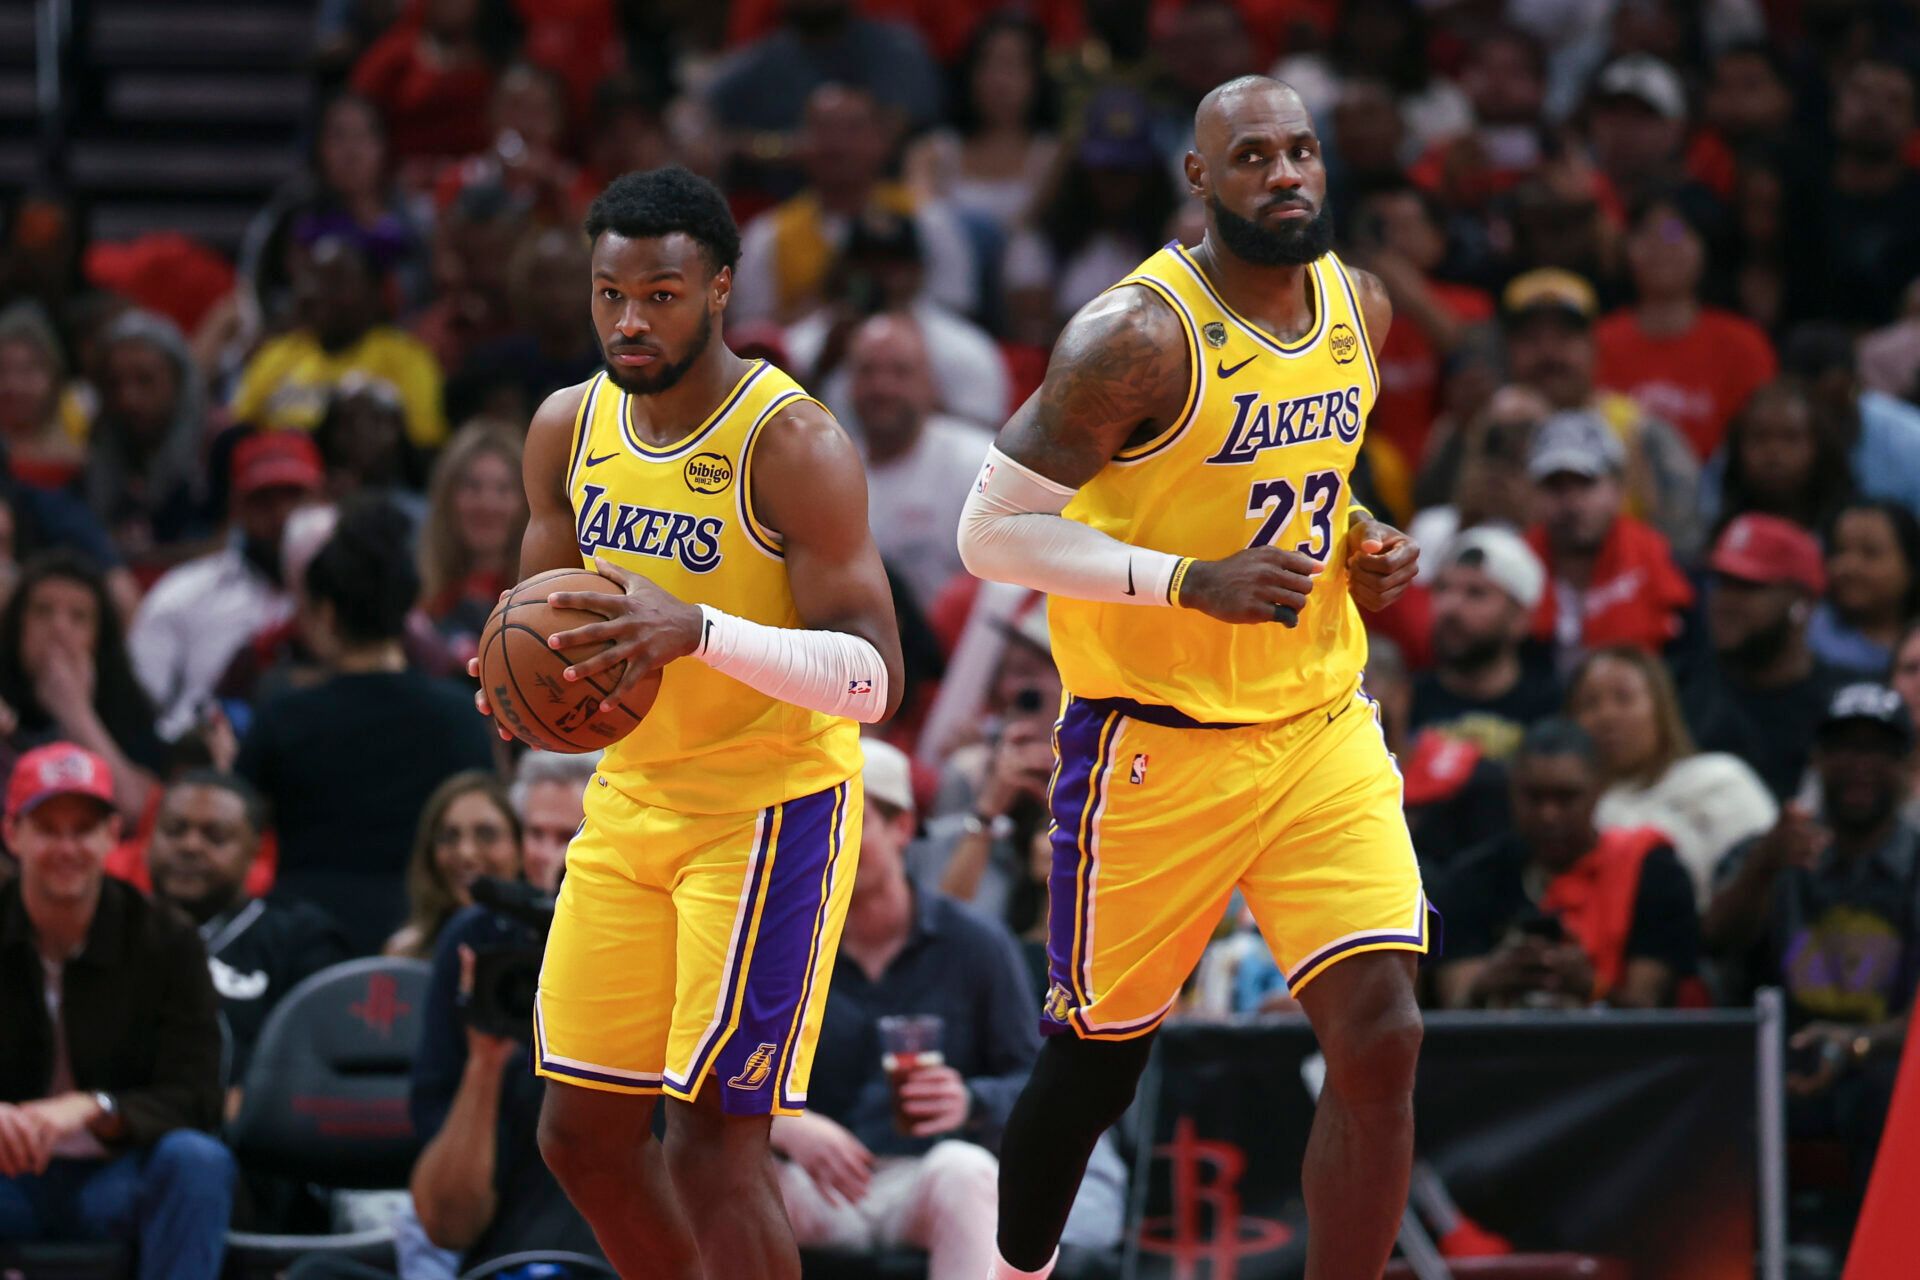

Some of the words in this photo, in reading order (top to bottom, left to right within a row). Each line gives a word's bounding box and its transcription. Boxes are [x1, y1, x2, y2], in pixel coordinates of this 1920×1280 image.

[1331, 335, 1355, 351] bibigo
[1203, 385, 1361, 466] LAKERS
[689, 462, 730, 484] bibigo
[576, 484, 725, 574] LAKERS
[1245, 470, 1343, 565] 23
